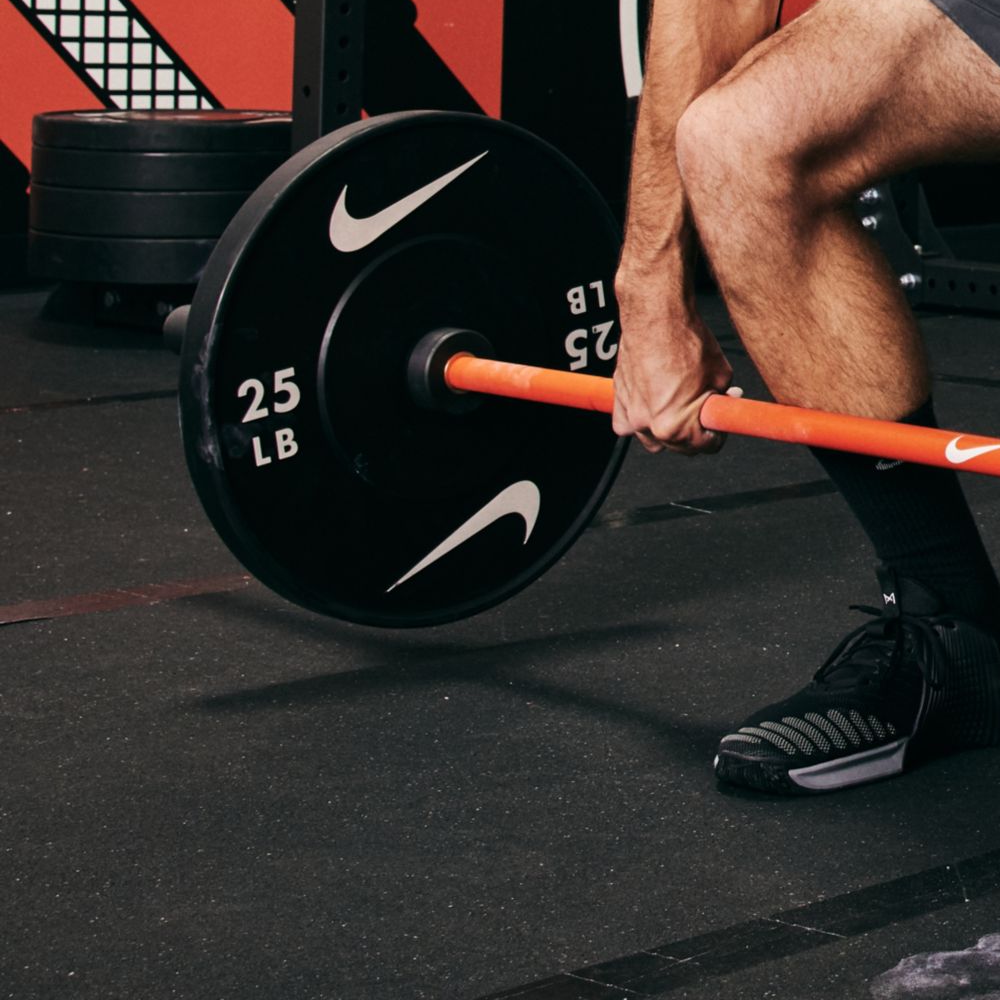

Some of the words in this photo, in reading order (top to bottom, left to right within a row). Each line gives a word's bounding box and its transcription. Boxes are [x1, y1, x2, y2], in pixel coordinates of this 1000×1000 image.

[566, 280, 605, 315] LB
[565, 320, 618, 371] 25
[237, 367, 300, 423] 25
[252, 428, 299, 467] LB
